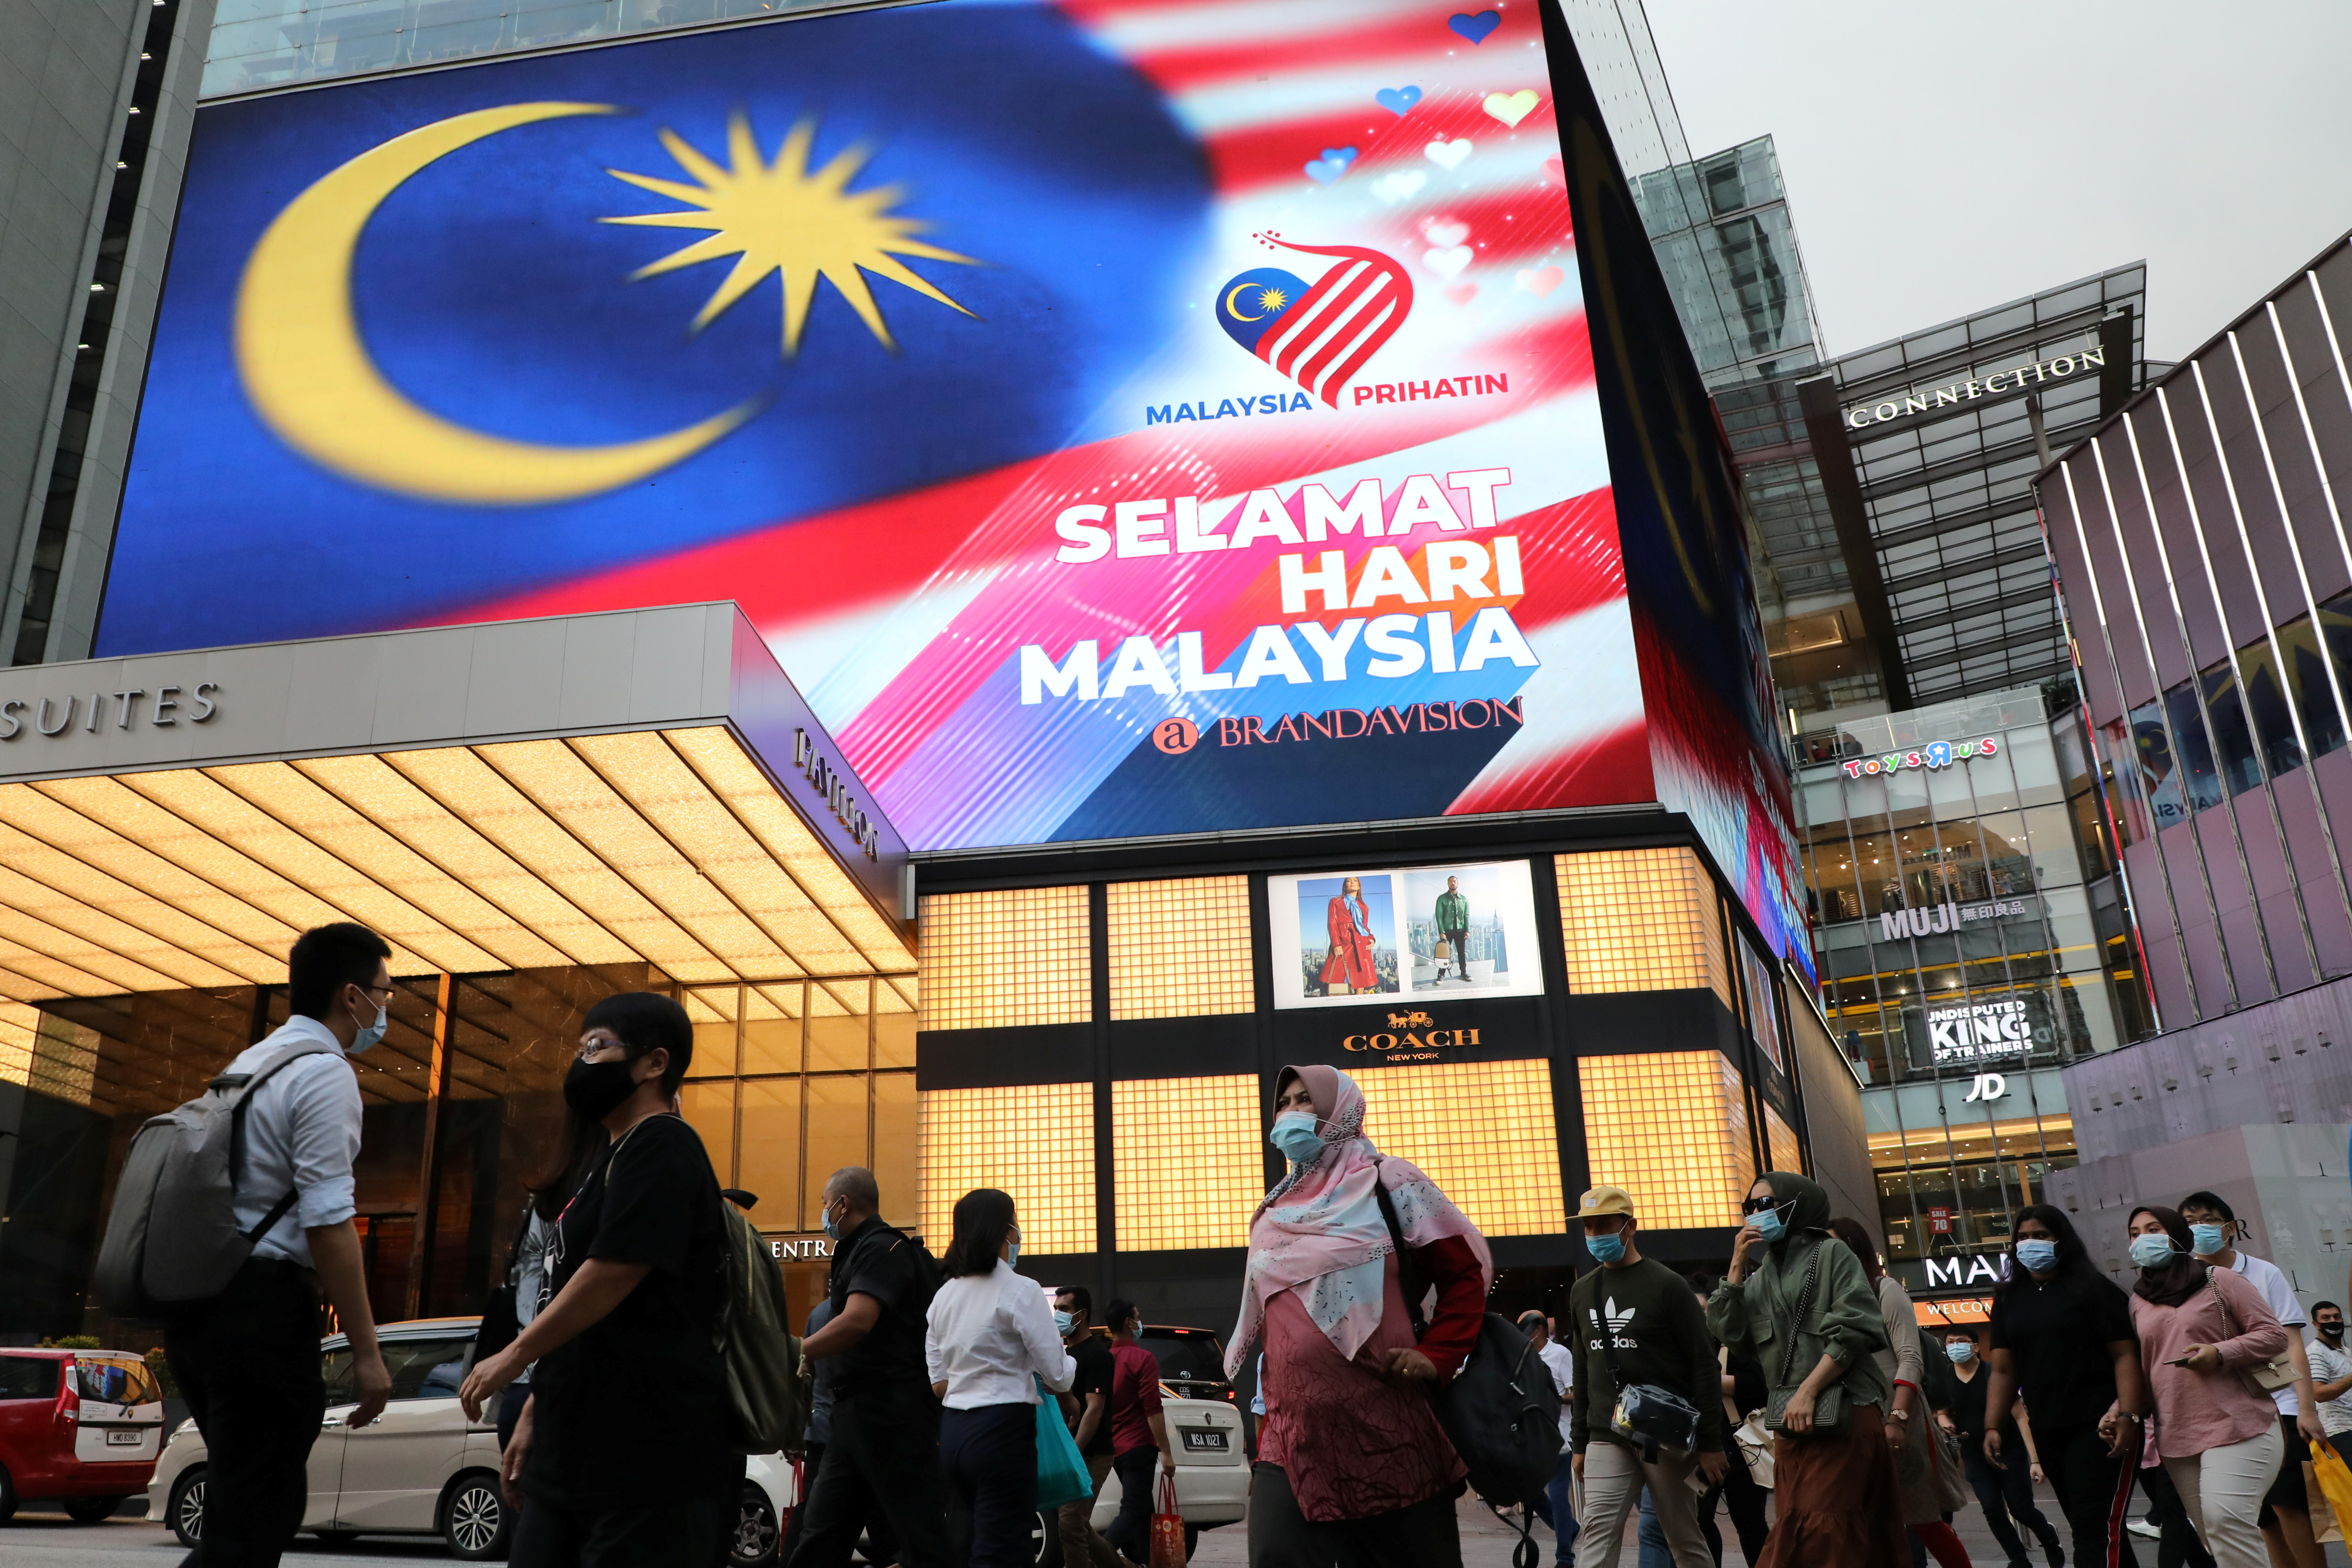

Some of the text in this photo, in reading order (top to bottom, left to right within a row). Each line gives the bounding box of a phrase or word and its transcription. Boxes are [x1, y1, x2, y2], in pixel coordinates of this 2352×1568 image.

[1146, 373, 1508, 425] MALAYSIA PRIHATIN
[1849, 348, 2105, 428] CONNECTION
[1055, 468, 1511, 564] SELAMAT
[1279, 537, 1525, 614] HARI
[1020, 606, 1540, 706] MALAYSIA
[0, 682, 218, 739] SUITES
[1220, 697, 1523, 747] BRANDAVISION
[797, 727, 879, 863] PAVILION
[1880, 902, 1960, 941] MUJI
[1961, 901, 2026, 921] 無印良品
[1343, 1029, 1481, 1051] COACH
[1930, 1012, 2030, 1049] KING
[1953, 1039, 2033, 1057] TRAINERS
[1966, 1073, 2005, 1102] JD
[1933, 1219, 1948, 1230] 70
[1191, 1434, 1219, 1445] WSA 1027
